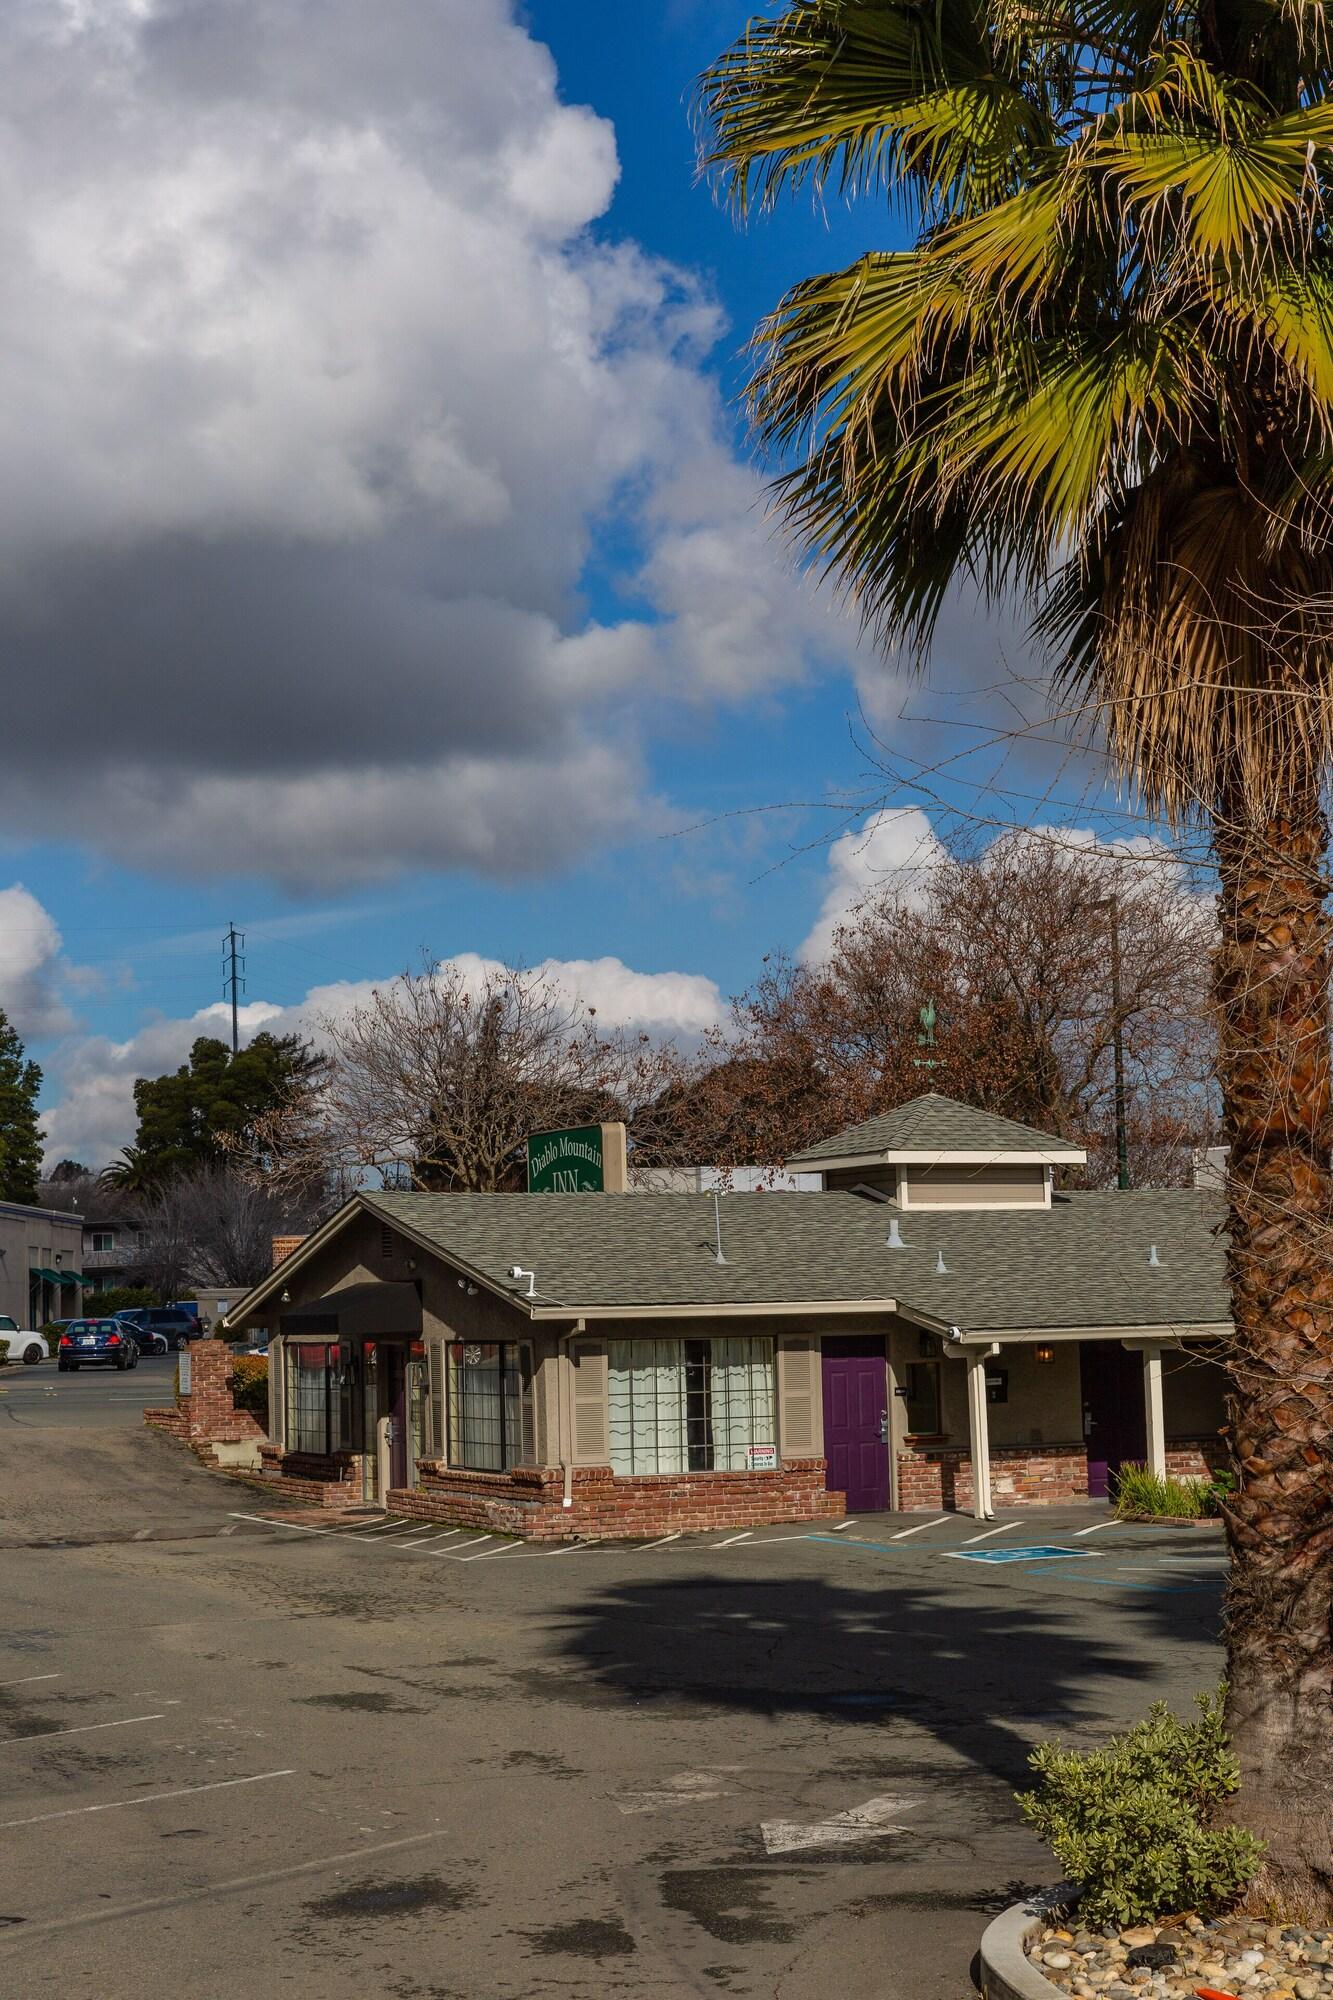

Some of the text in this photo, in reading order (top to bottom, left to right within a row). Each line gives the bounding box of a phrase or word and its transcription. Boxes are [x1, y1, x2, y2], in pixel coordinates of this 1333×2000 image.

[531, 1136, 602, 1178] Diablo Mountain
[552, 1168, 579, 1194] INN
